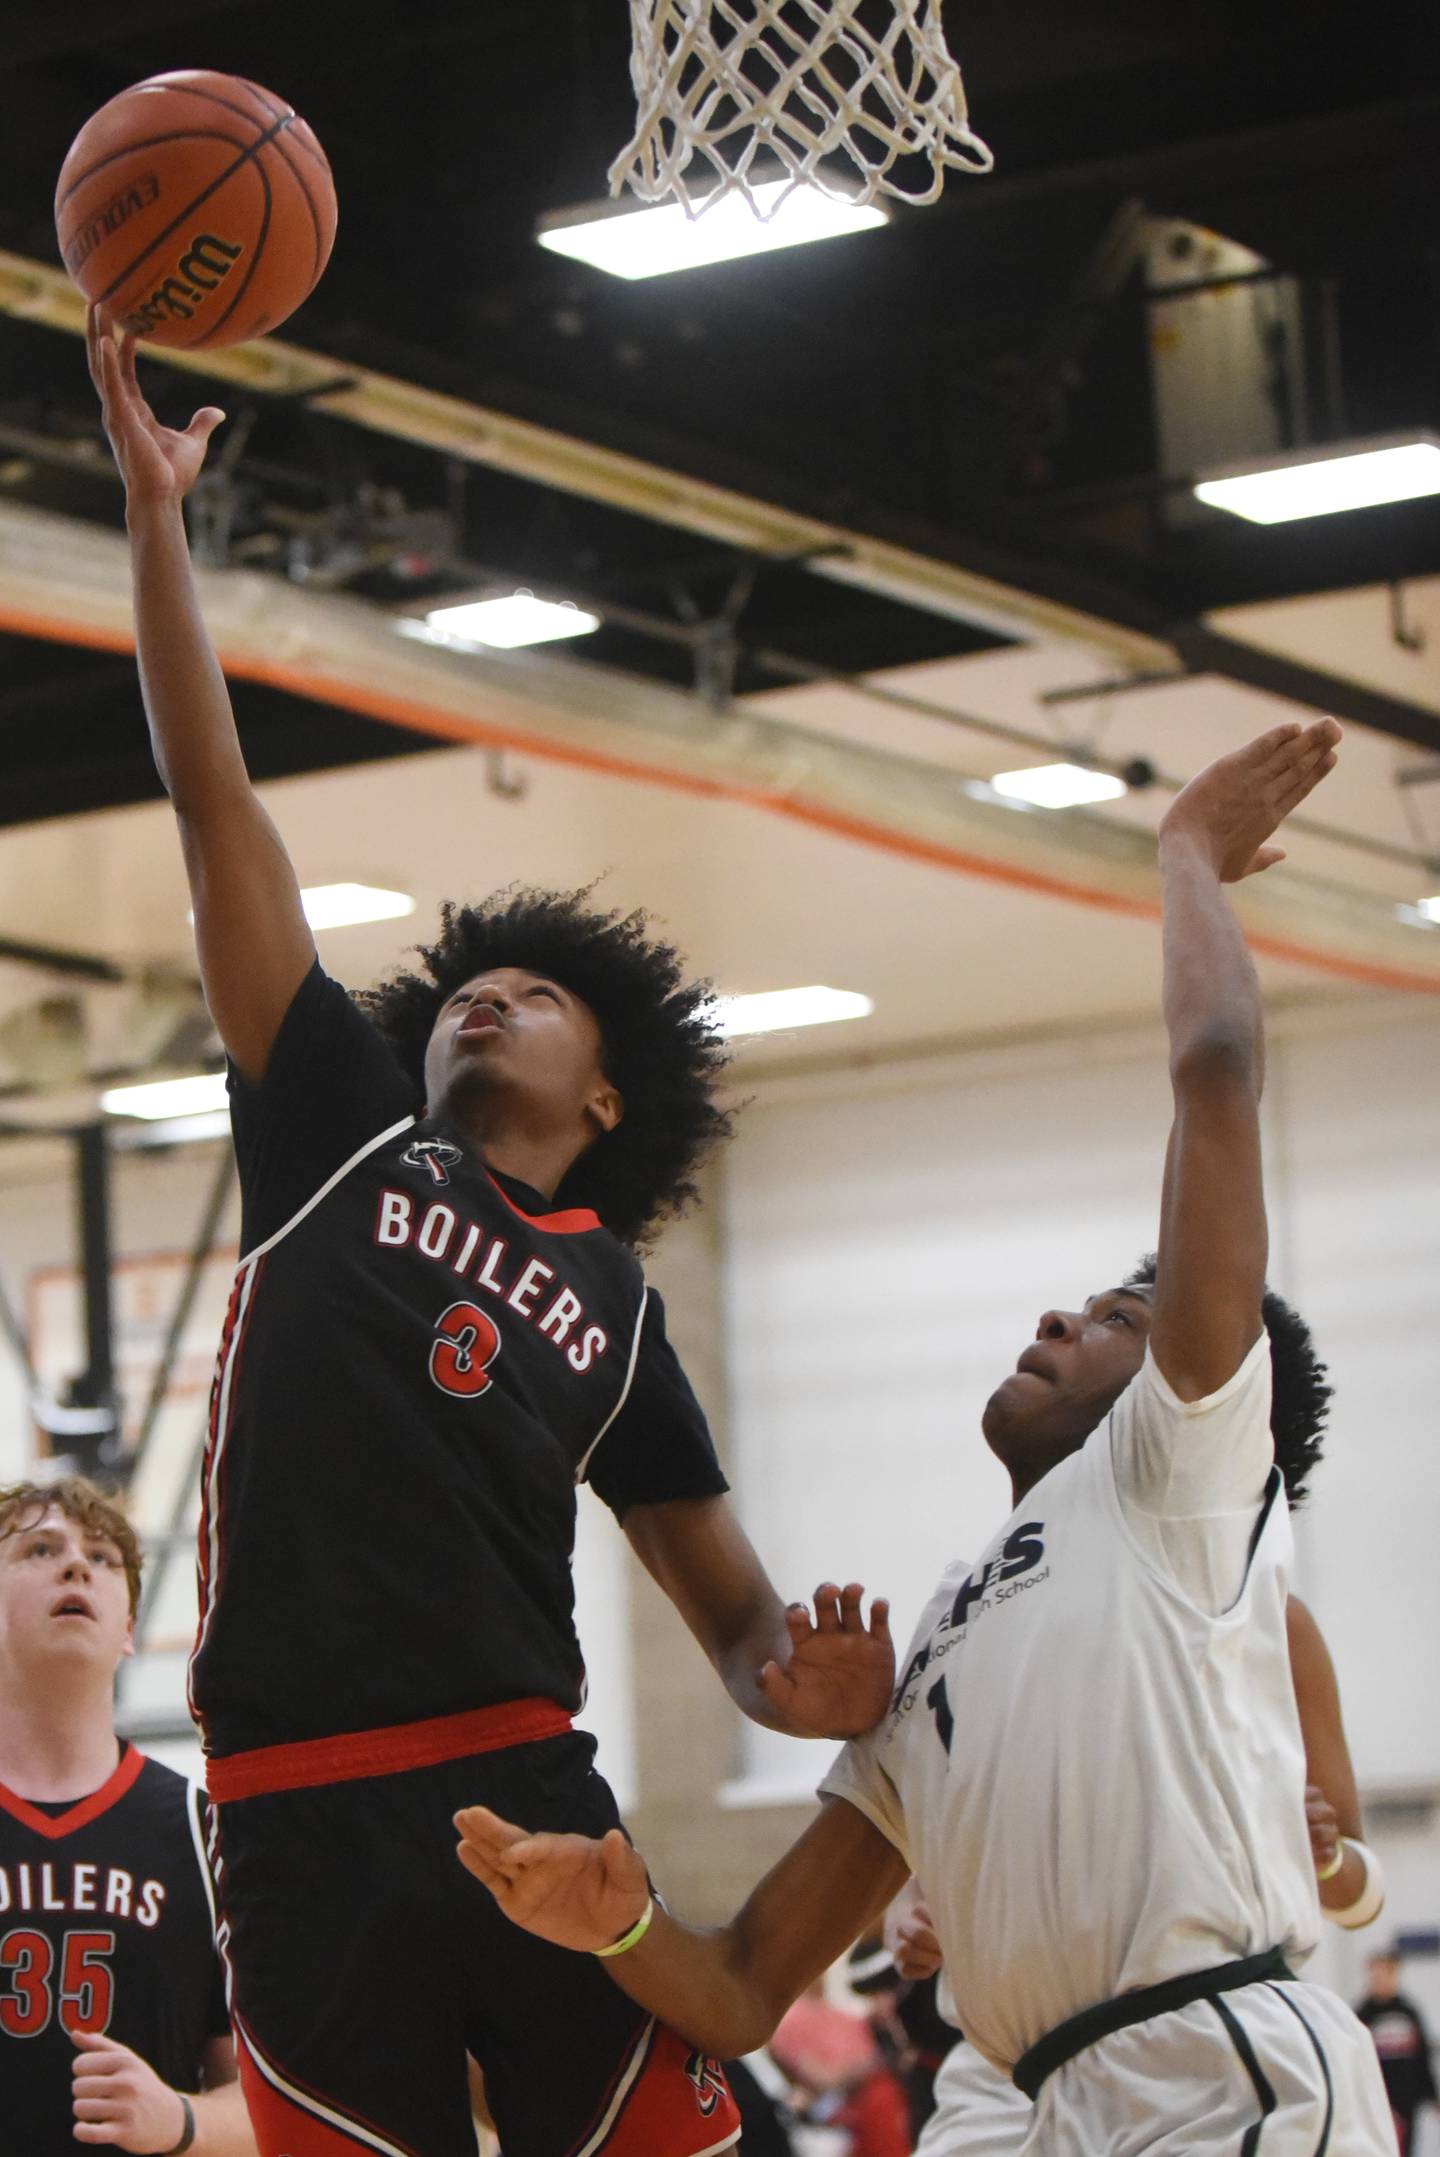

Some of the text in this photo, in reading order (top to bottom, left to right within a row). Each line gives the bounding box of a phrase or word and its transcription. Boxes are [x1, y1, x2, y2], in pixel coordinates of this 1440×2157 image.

[376, 1190, 607, 1373] BOILERS
[429, 1300, 501, 1398] 3
[995, 1565, 1050, 1605] School
[0, 1927, 116, 2039] 35
